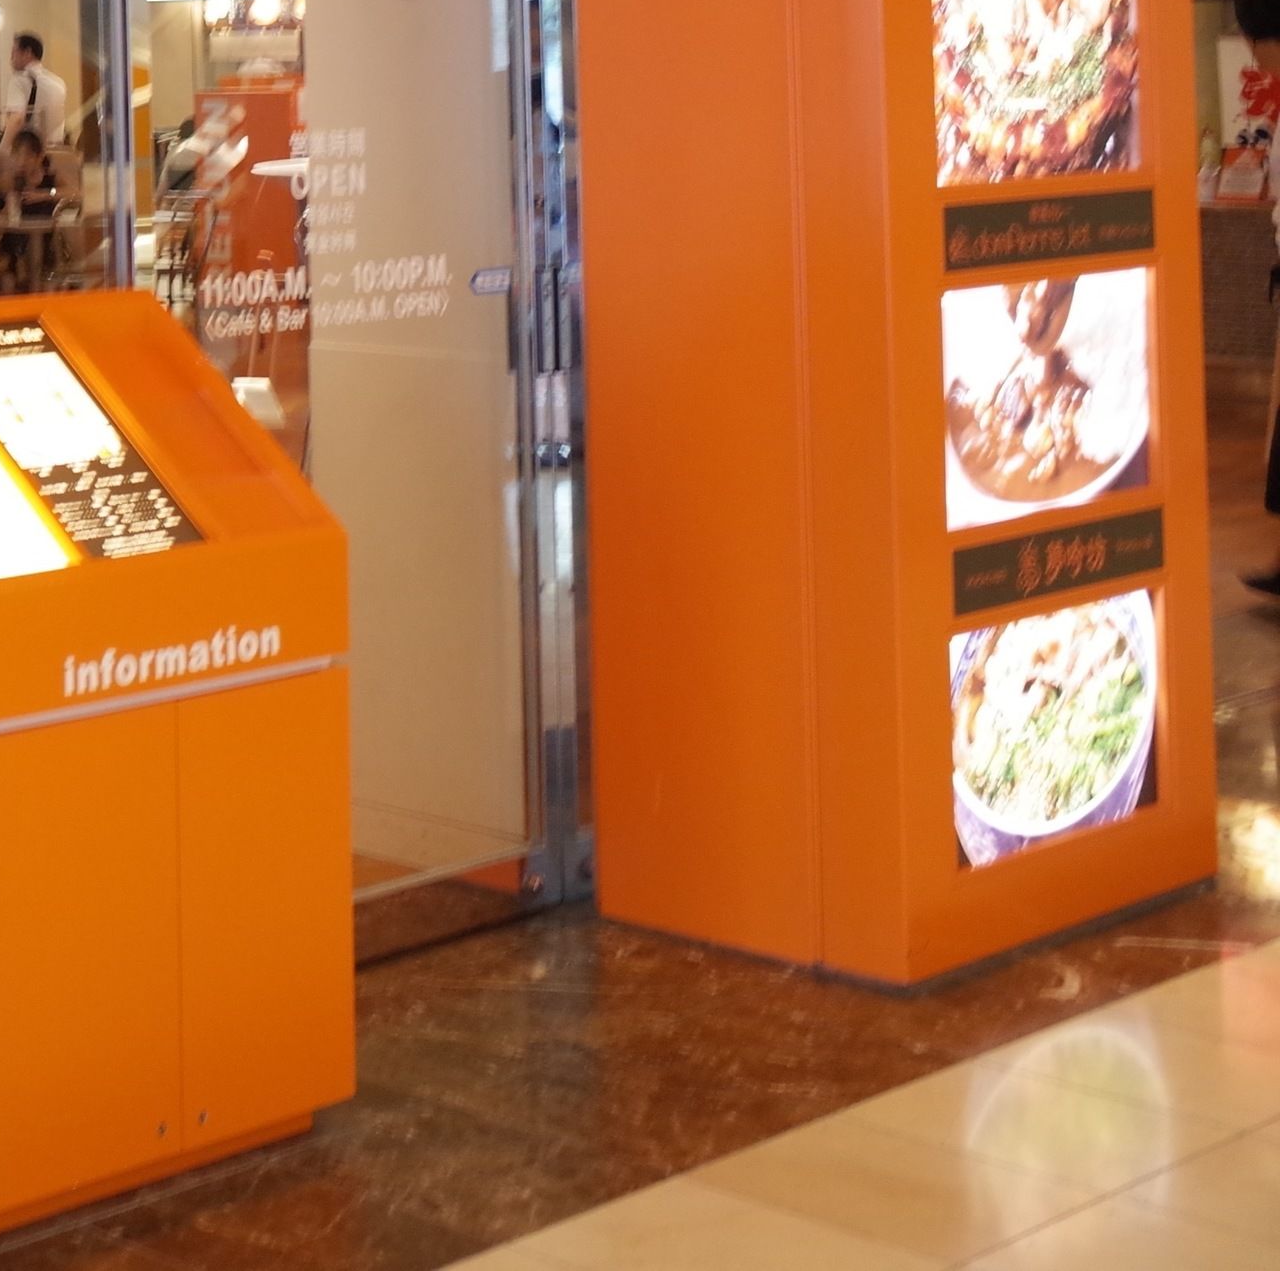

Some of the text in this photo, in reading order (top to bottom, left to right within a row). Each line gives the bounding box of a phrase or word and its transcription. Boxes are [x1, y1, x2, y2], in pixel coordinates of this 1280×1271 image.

[290, 162, 367, 201] OPEN
[258, 308, 272, 334] &
[276, 305, 309, 333] Bar
[63, 624, 282, 698] information
